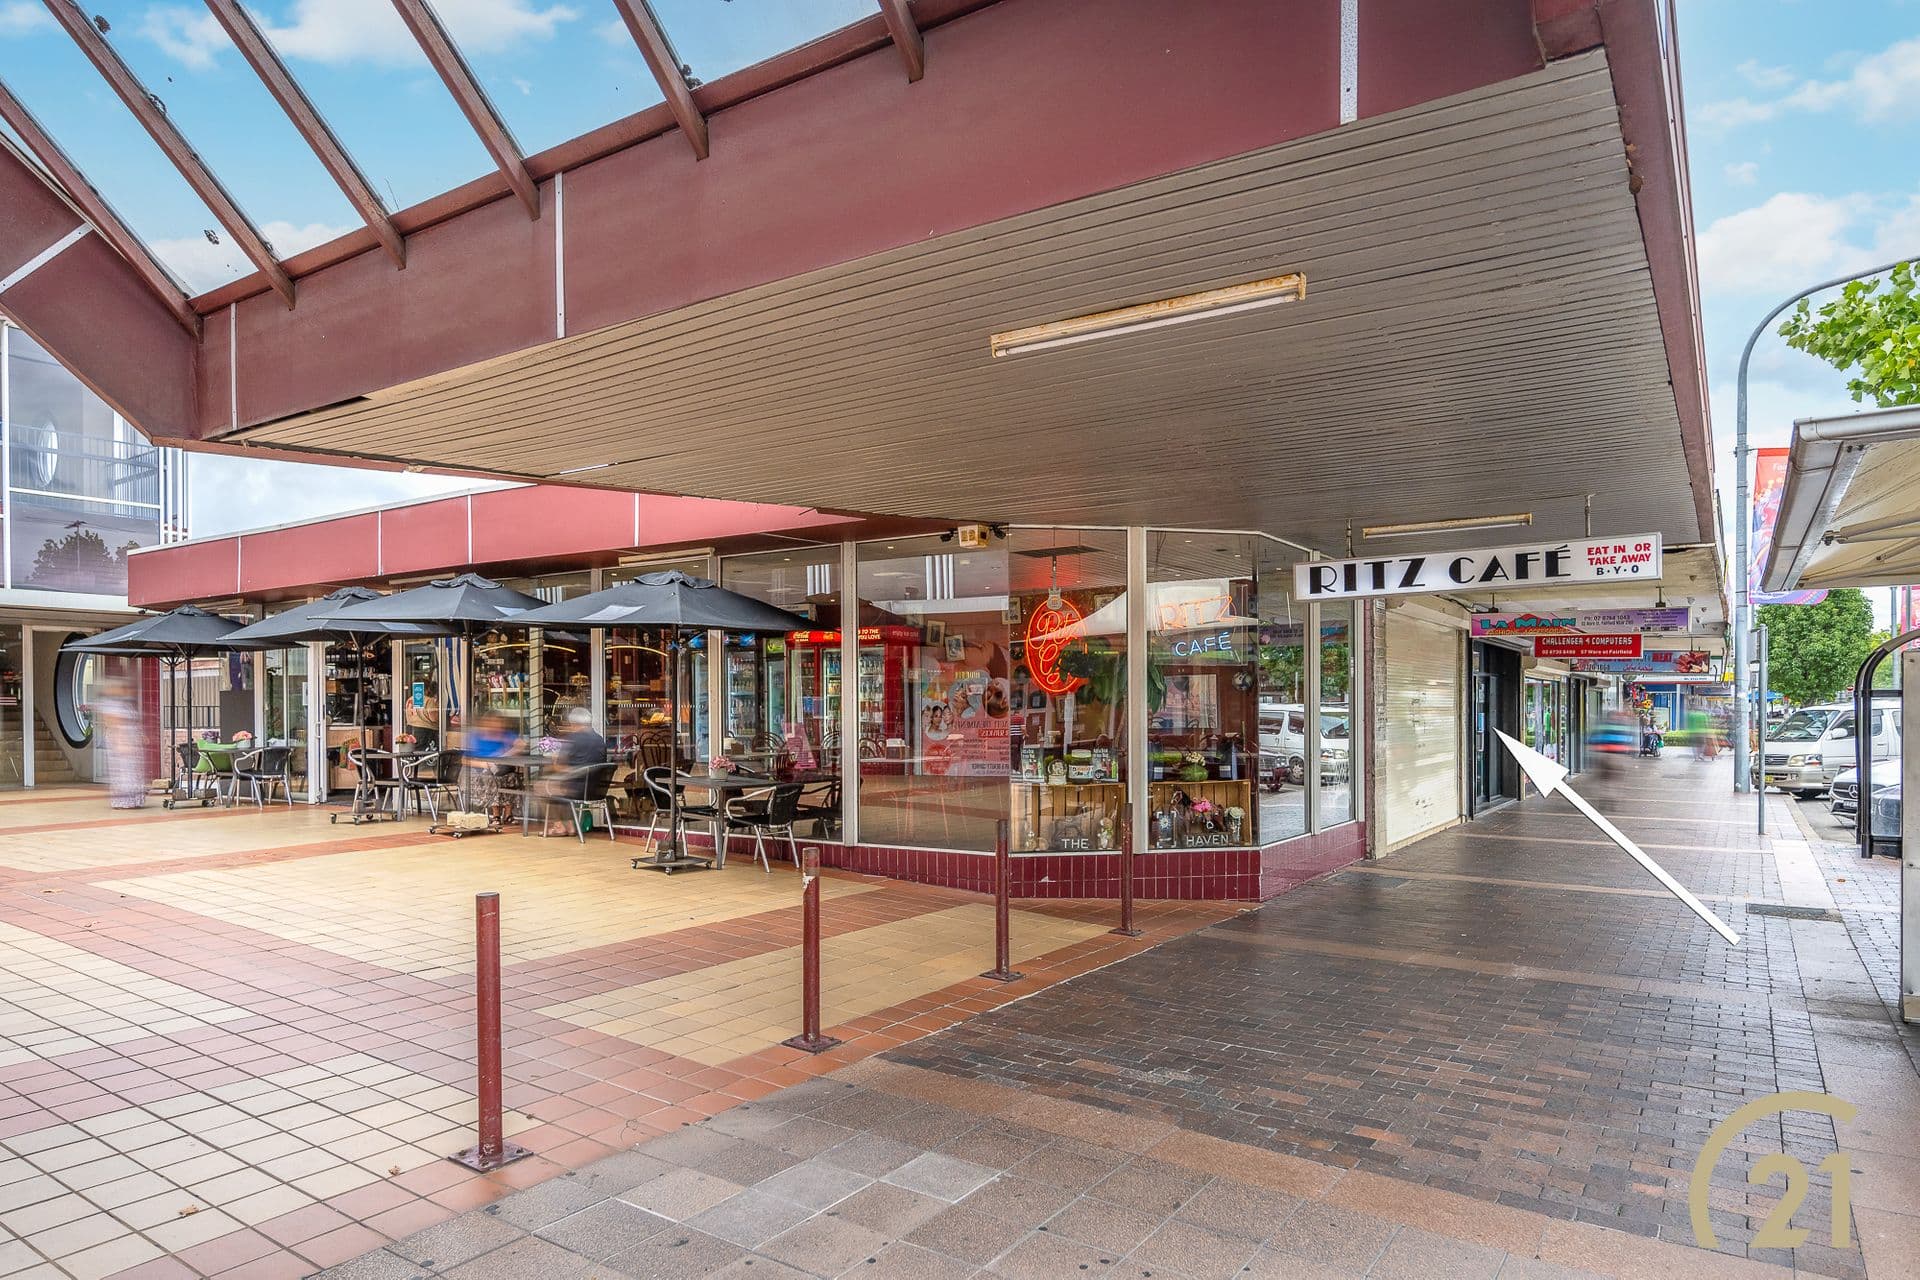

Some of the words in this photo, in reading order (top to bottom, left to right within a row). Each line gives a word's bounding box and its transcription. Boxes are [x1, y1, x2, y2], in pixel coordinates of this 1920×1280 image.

[1587, 546, 1609, 556] EAT
[1613, 545, 1626, 554] IN
[1634, 543, 1651, 552] OR
[1587, 556, 1617, 566] TAKE
[1620, 553, 1652, 564] AWAY
[1309, 557, 1426, 594] RITZ
[1449, 544, 1571, 584] CAFÉ
[1175, 632, 1232, 657] CAFÉ
[1541, 637, 1584, 646] CHALLENGER
[1591, 636, 1633, 646] COMPUTERS
[1061, 838, 1089, 849] THE
[1186, 834, 1229, 847] HAVEN
